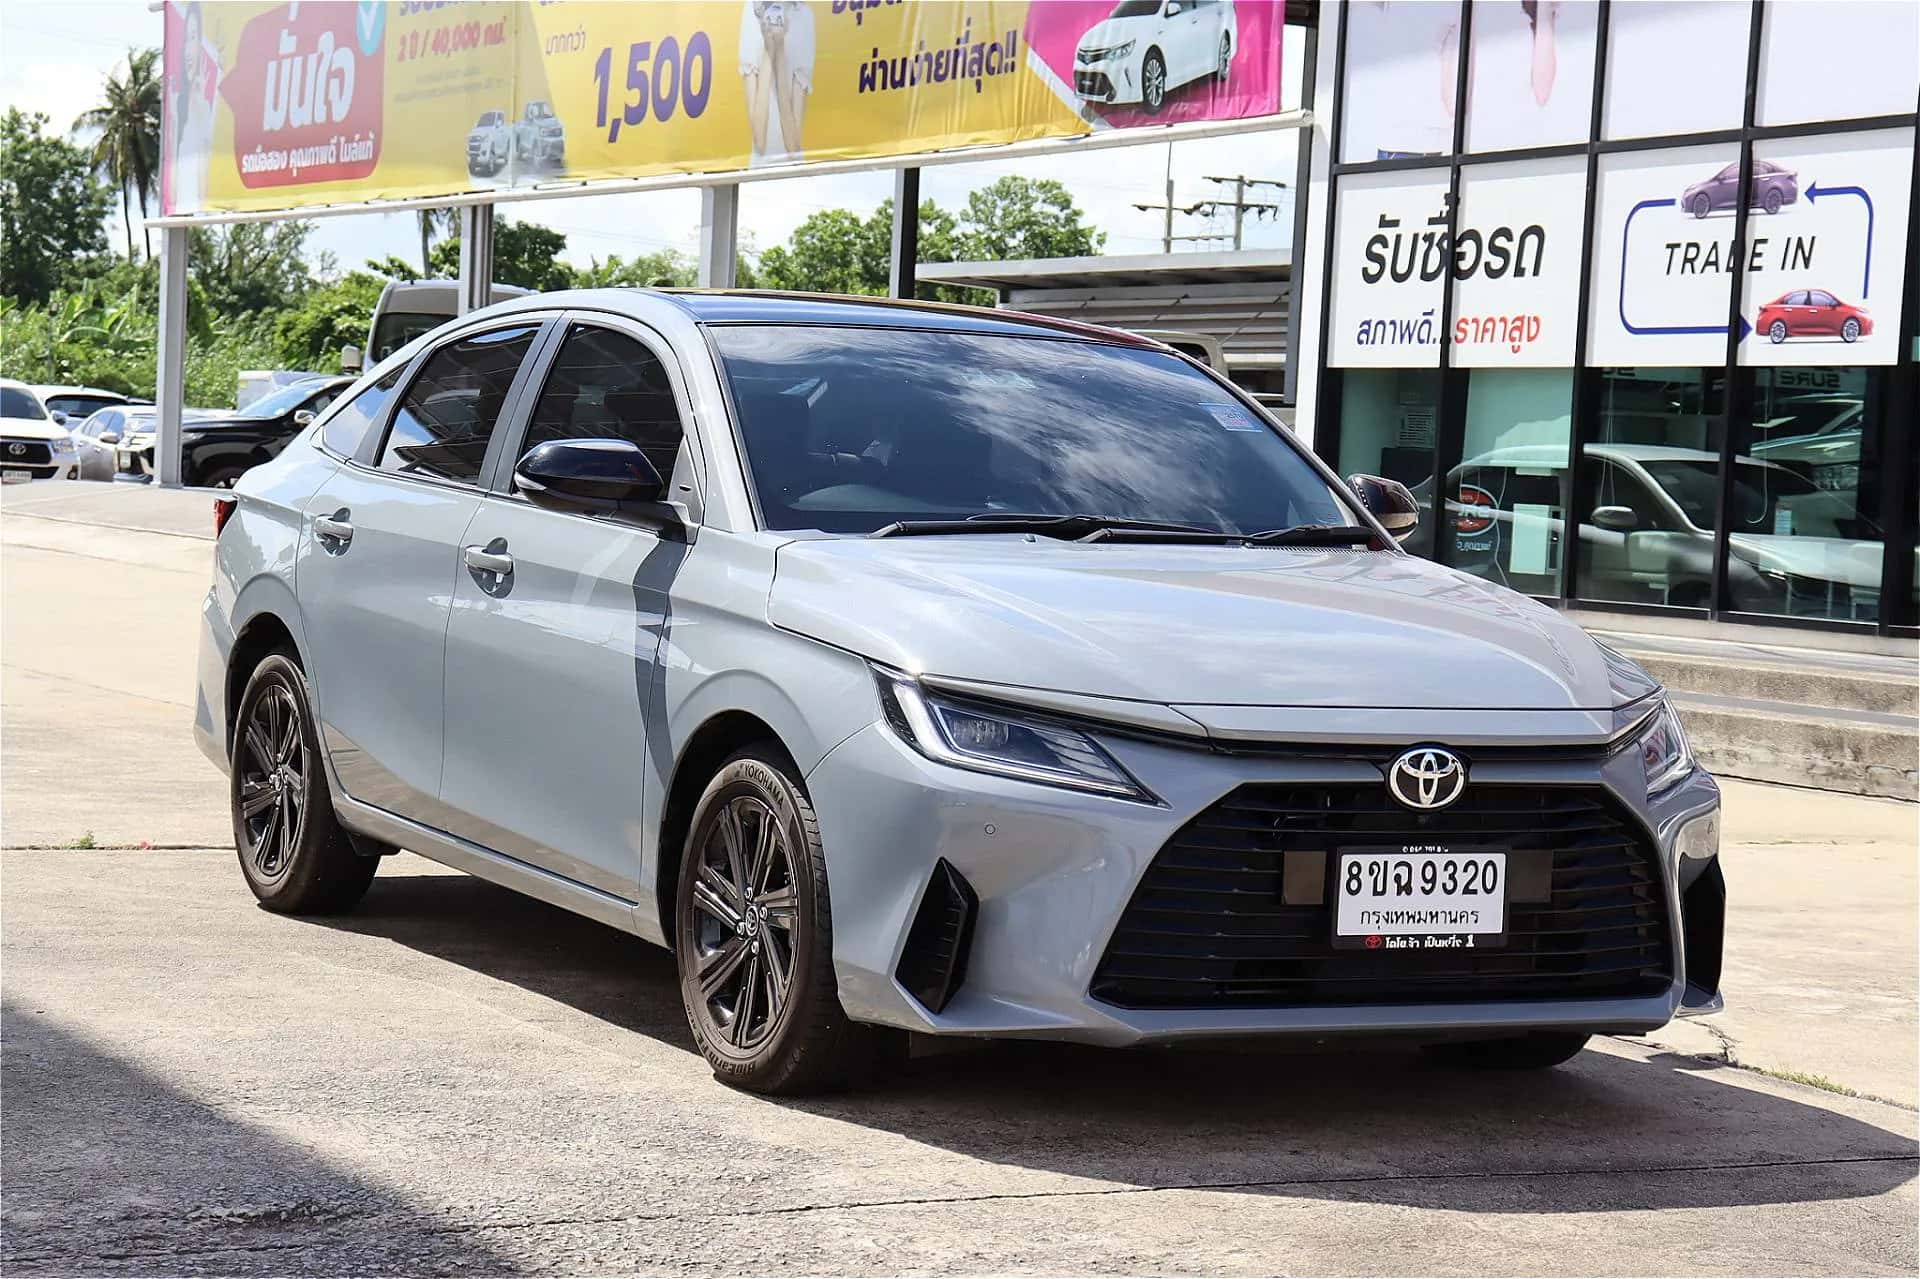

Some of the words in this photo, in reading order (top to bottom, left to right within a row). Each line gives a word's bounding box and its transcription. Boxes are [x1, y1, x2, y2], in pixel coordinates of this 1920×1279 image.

[545, 24, 587, 55] มากกว่า
[593, 31, 713, 144] 1,500
[289, 136, 338, 177] คุณภาพดี
[339, 131, 374, 162] ไมล์แท้
[1361, 192, 1546, 284] รับซื้อรถ
[1780, 235, 1817, 271] IN
[744, 763, 785, 810] YOKOHAMA
[1420, 859, 1498, 896] 9320
[1360, 910, 1480, 930] กรุงเทพมหานคร
